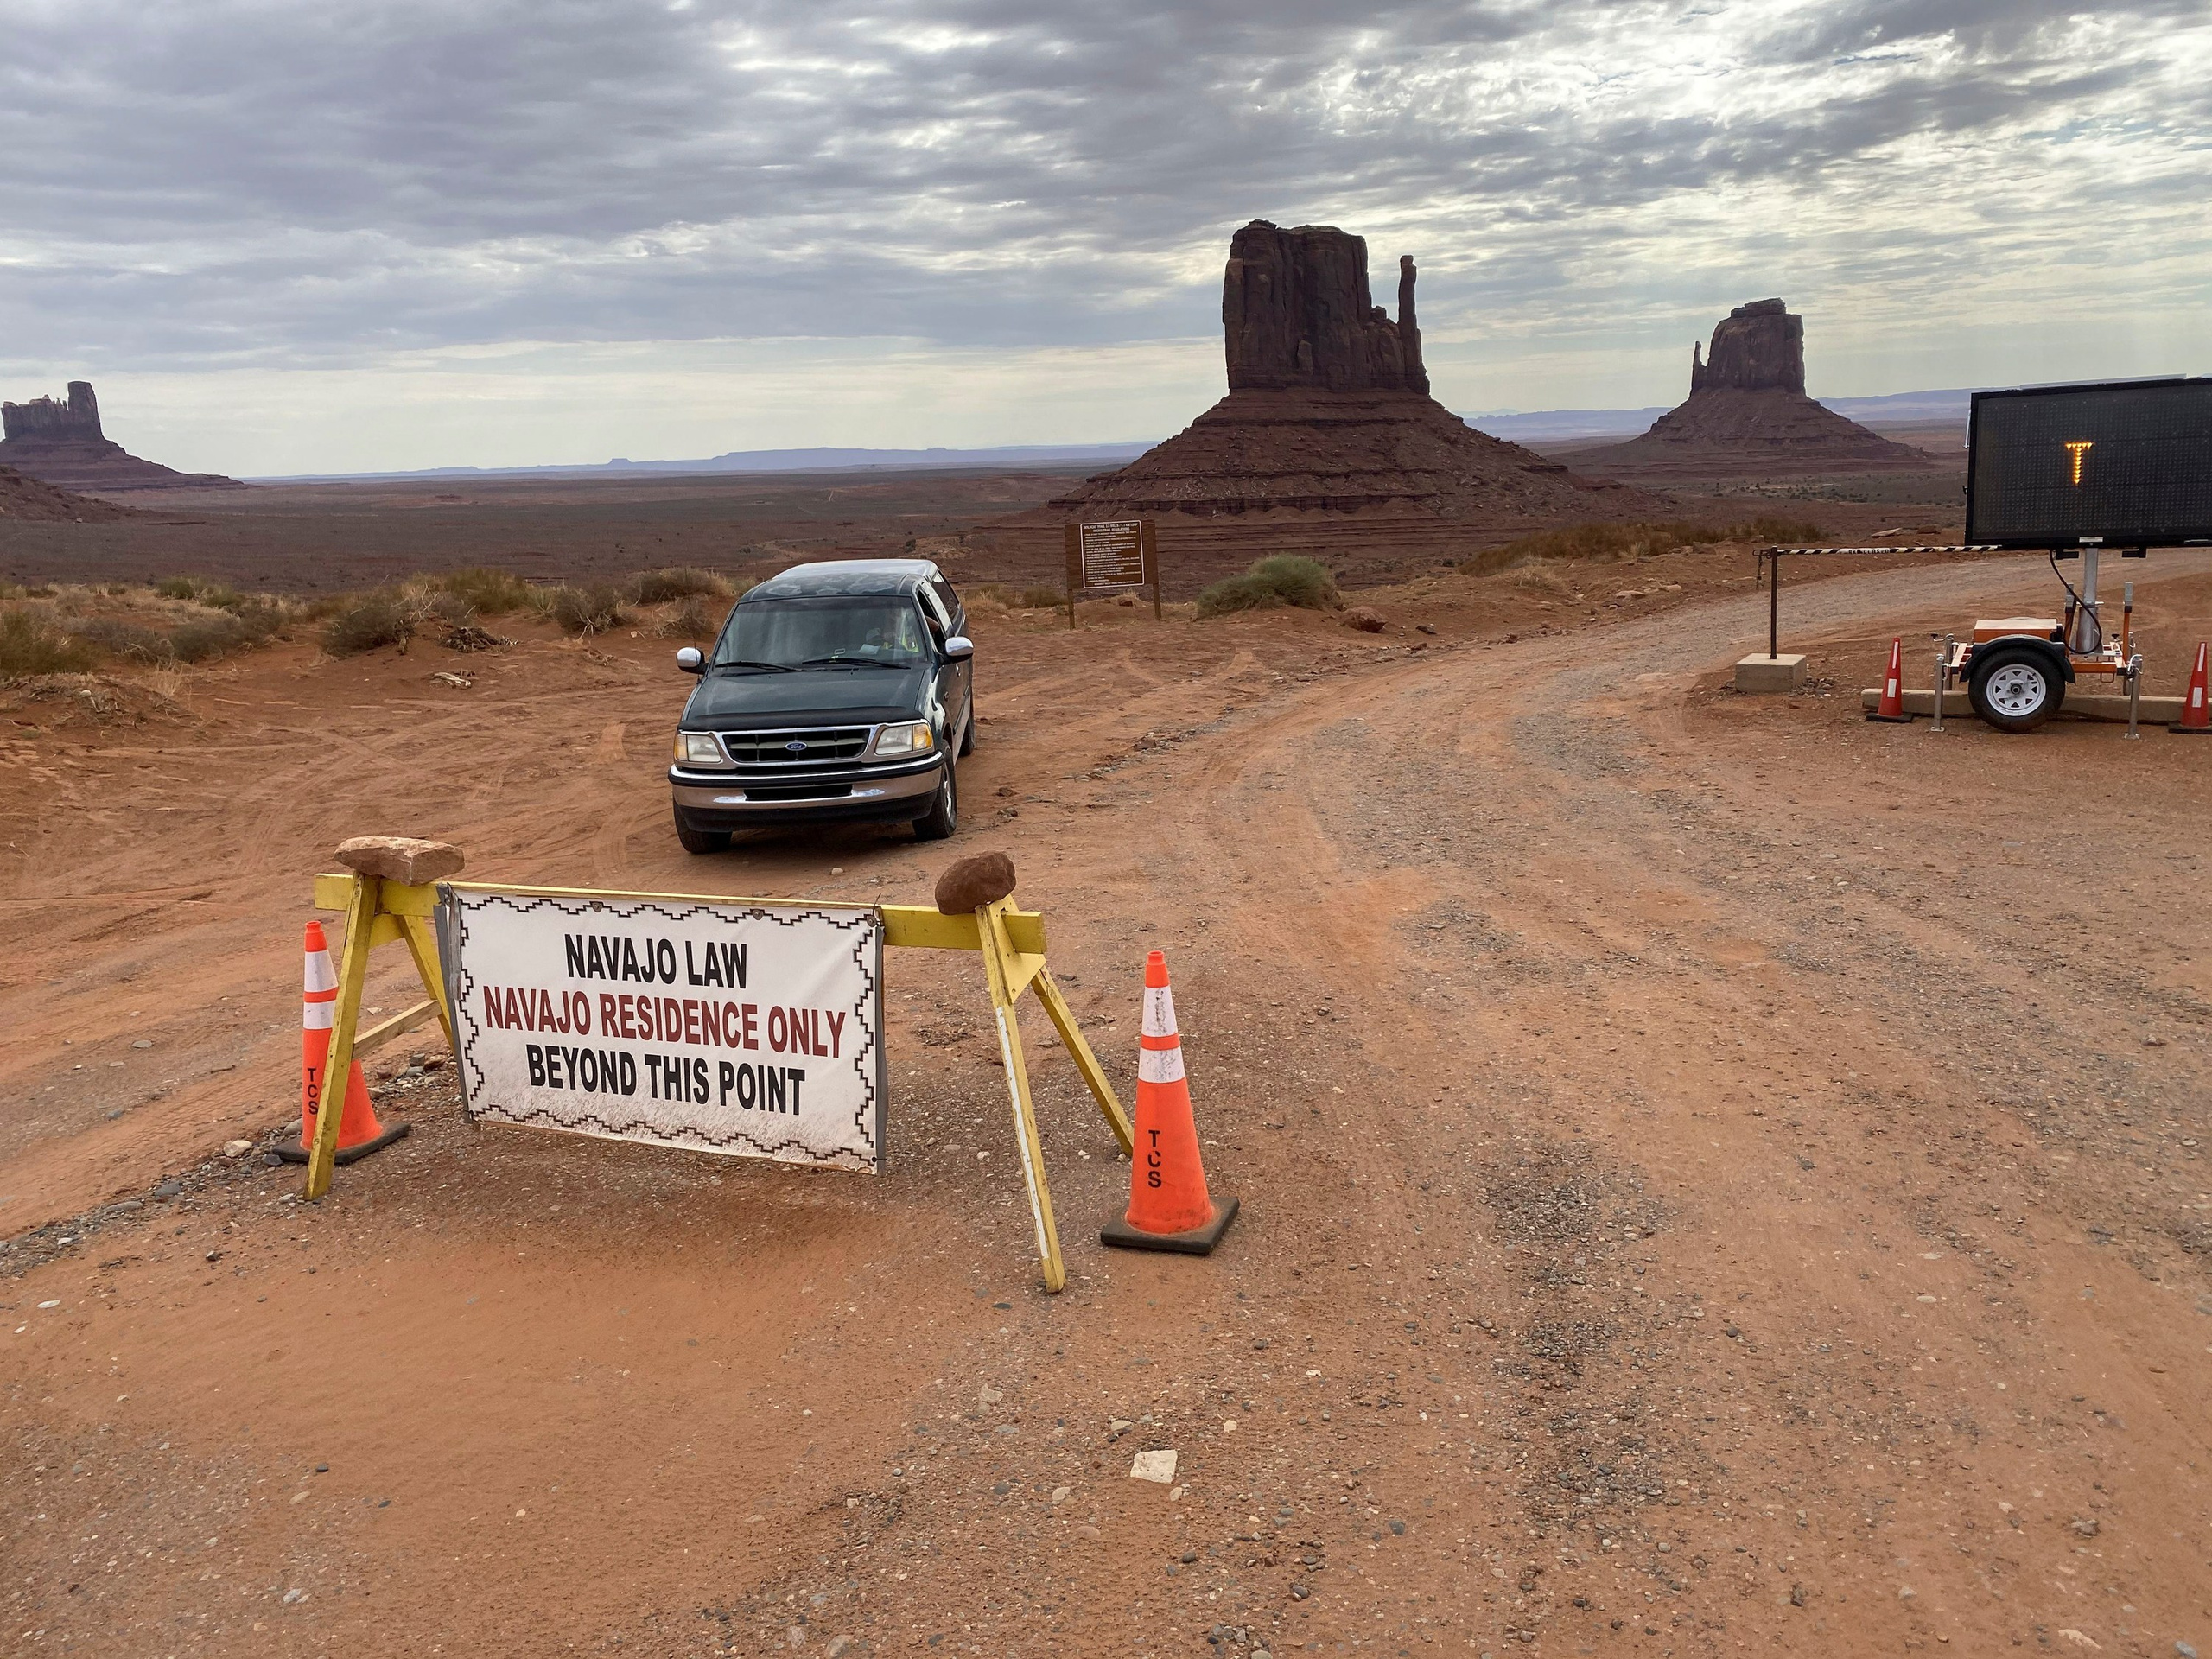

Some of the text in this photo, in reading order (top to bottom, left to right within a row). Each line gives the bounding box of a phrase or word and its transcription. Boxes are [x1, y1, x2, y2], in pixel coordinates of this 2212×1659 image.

[2064, 441, 2094, 486] T
[564, 934, 747, 989] NAVAJO LAW
[483, 985, 847, 1058] NAVAJO RESIDENCE ONLY
[307, 1067, 319, 1116] TCS
[526, 1044, 805, 1116] BEYOND THIS POINT
[1147, 1129, 1162, 1188] TCS
